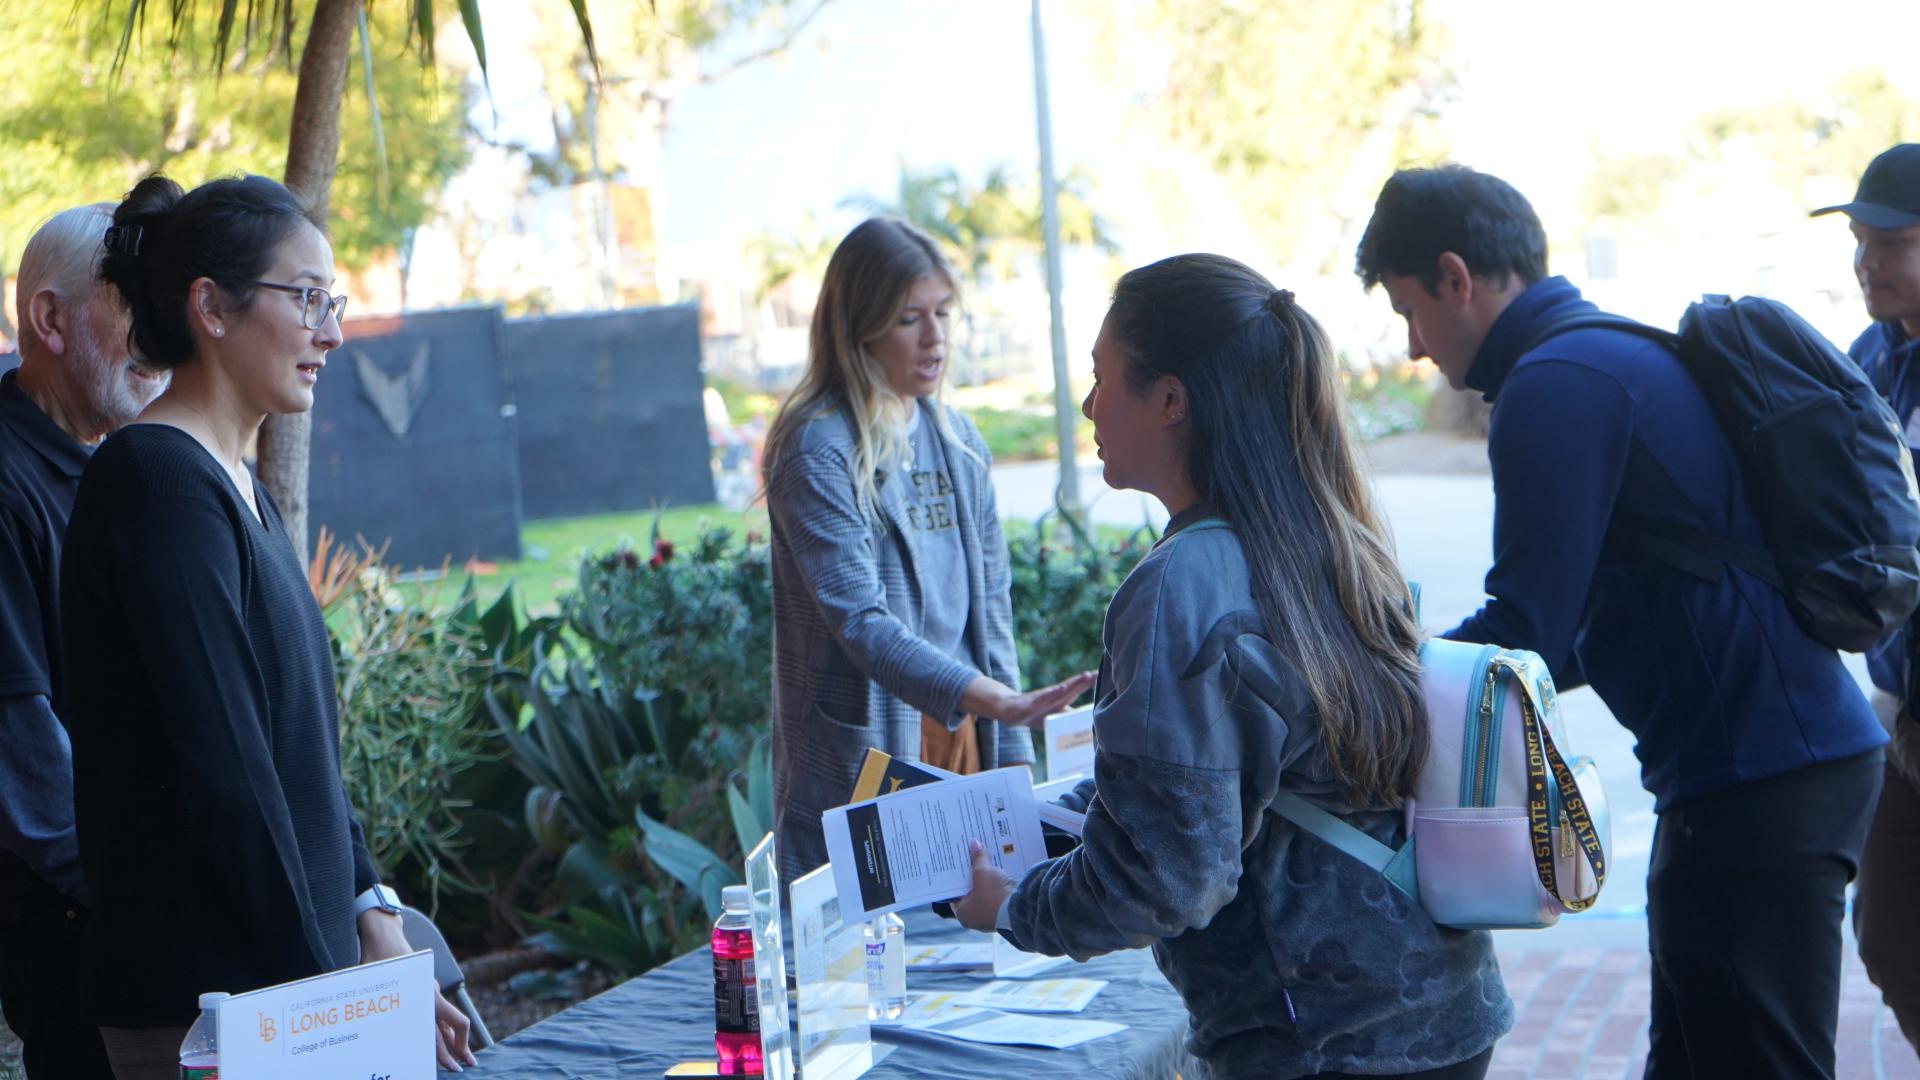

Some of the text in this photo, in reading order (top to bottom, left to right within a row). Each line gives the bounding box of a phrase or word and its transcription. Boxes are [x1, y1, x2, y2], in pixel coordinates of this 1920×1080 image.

[1527, 731, 1545, 777] LONG
[1546, 744, 1577, 796] BEACH
[290, 980, 399, 1012] CALIFORNIA STATE UNIVERSITY
[290, 992, 401, 1034] LONG BEACH
[291, 1032, 359, 1055] College of Business
